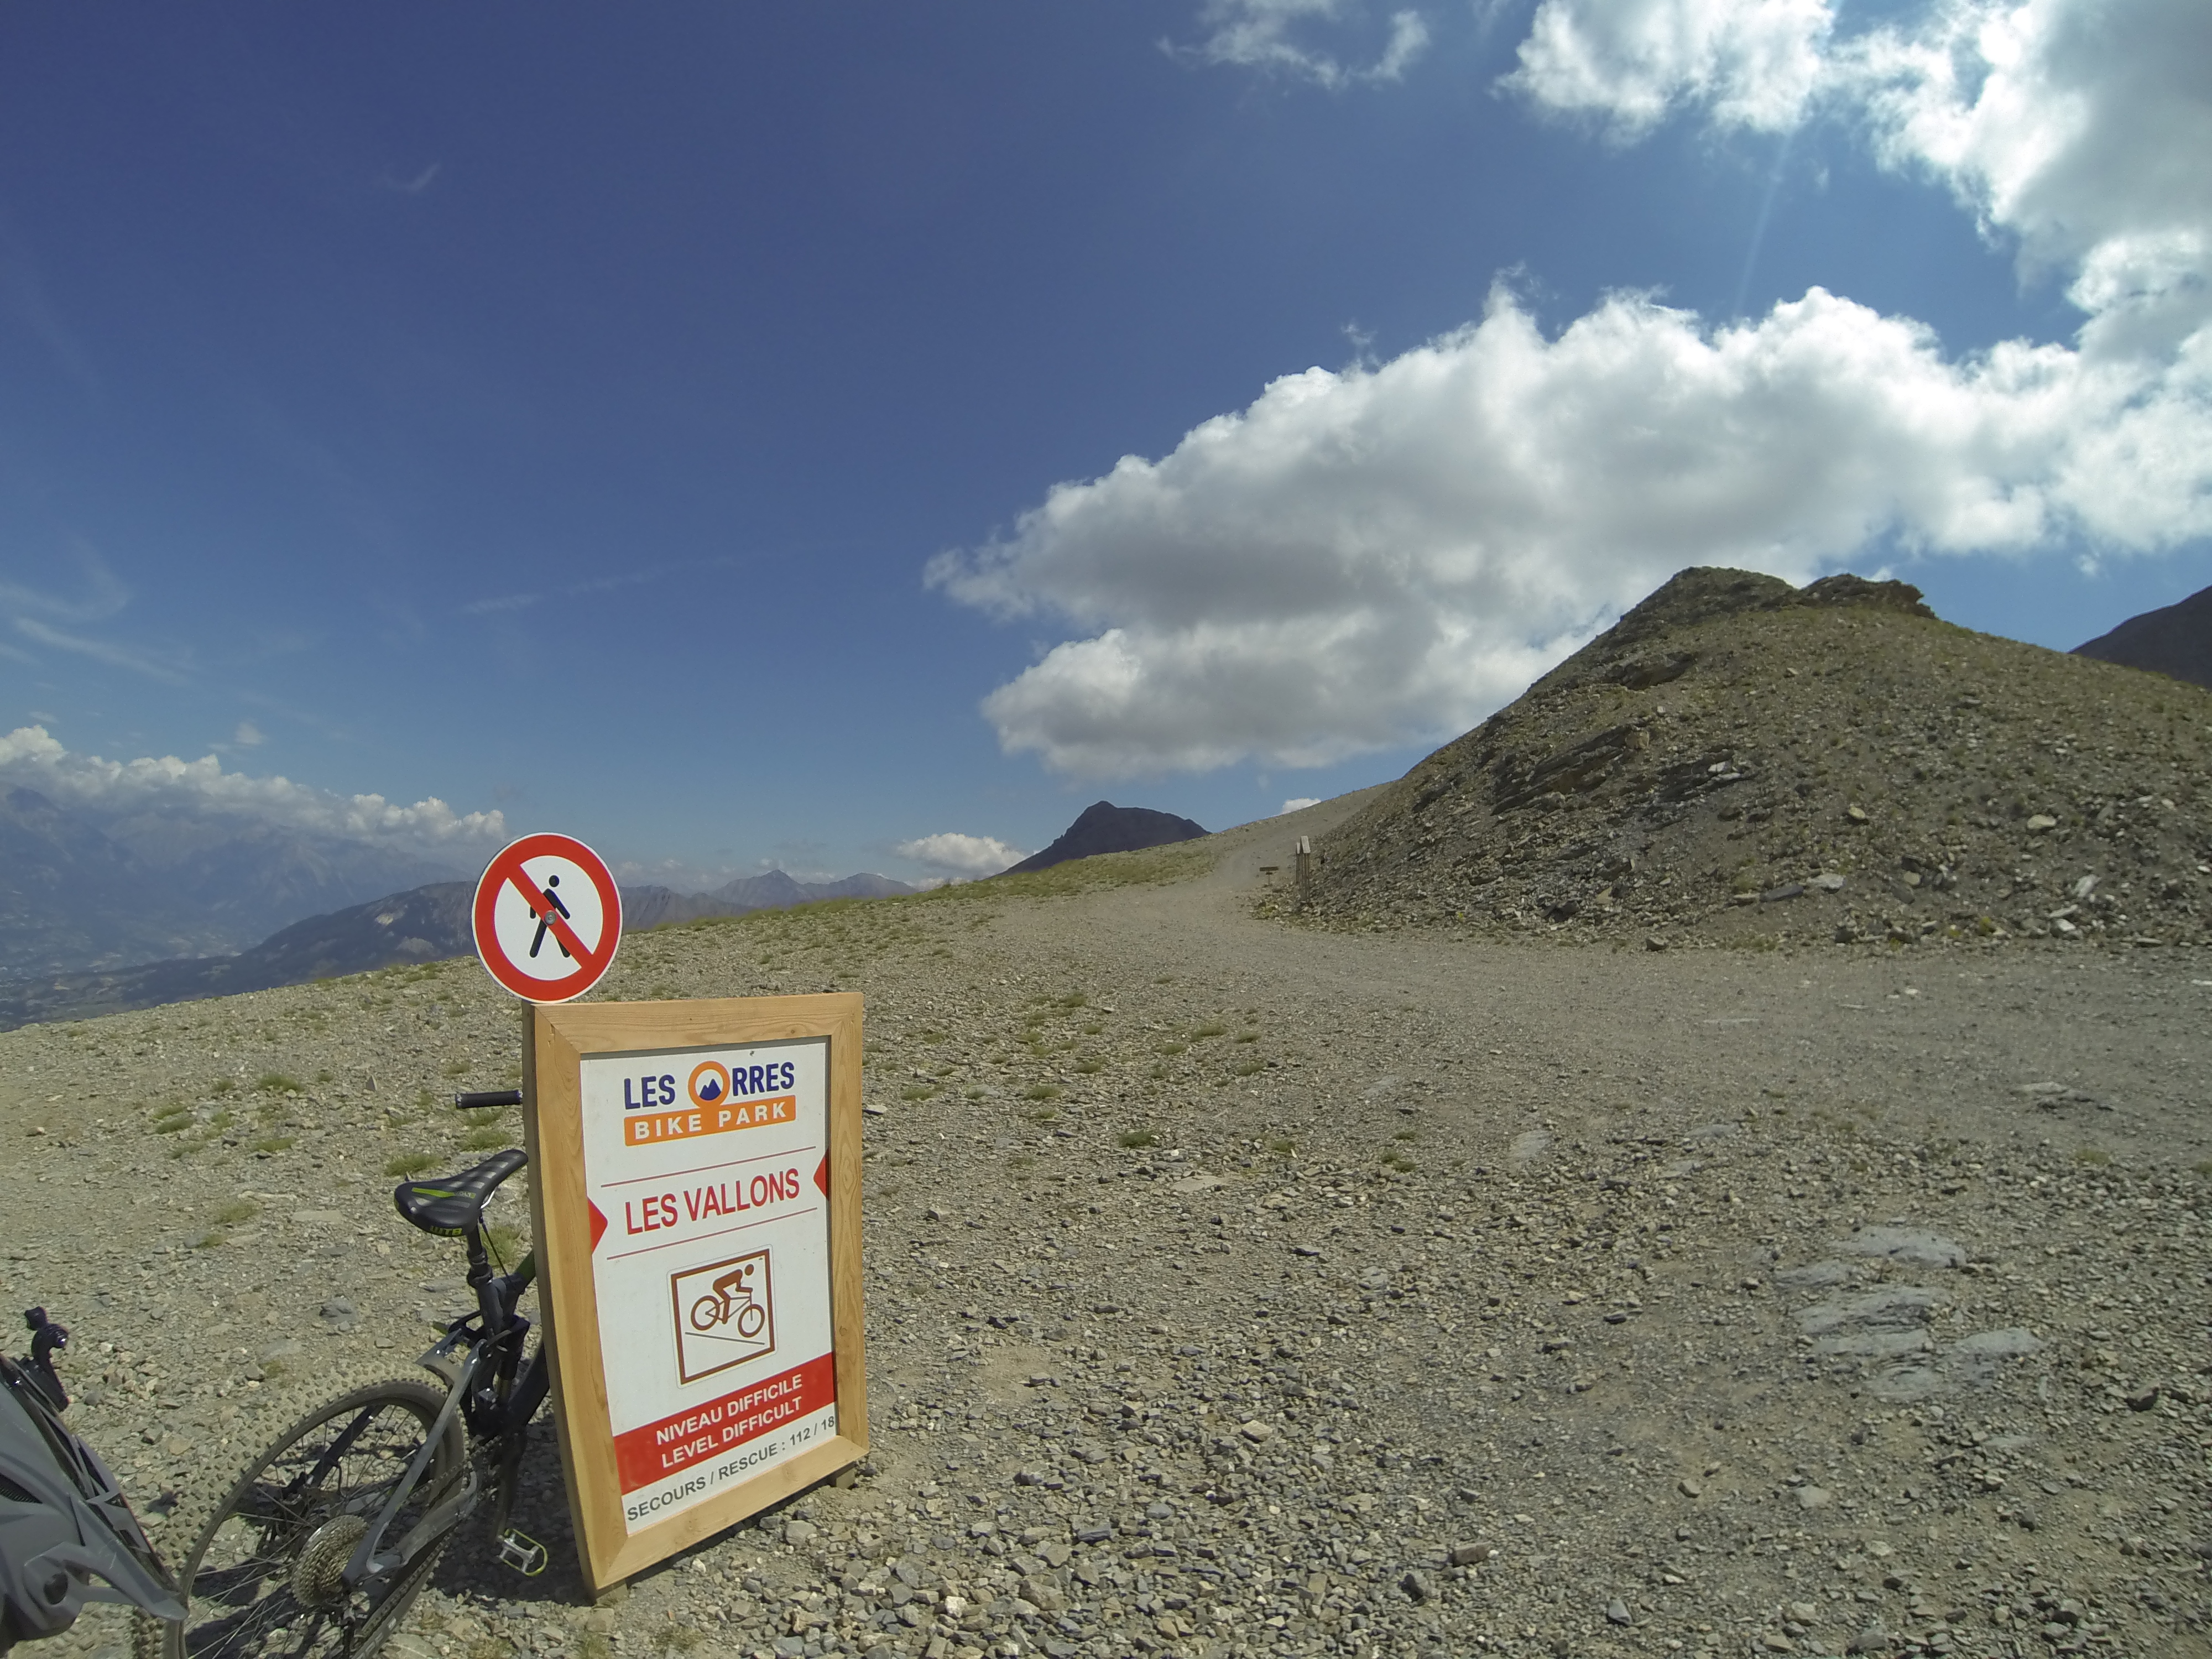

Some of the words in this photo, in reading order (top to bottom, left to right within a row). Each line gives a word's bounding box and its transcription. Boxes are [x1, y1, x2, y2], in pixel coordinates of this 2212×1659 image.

[624, 1074, 675, 1109] LES
[634, 1114, 701, 1140] BIKE
[719, 1102, 786, 1127] PARK
[625, 1193, 678, 1235] LES
[684, 1168, 800, 1221] VALLONS
[656, 1406, 722, 1446] NIVEAU
[727, 1374, 802, 1417] DIFFICILE
[662, 1439, 718, 1468] LEVEL
[722, 1396, 802, 1443] DIFFICULT
[627, 1476, 706, 1521] SECOURS
[718, 1442, 778, 1480] RESCUE
[789, 1427, 811, 1446] 112
[821, 1416, 834, 1430] 18
